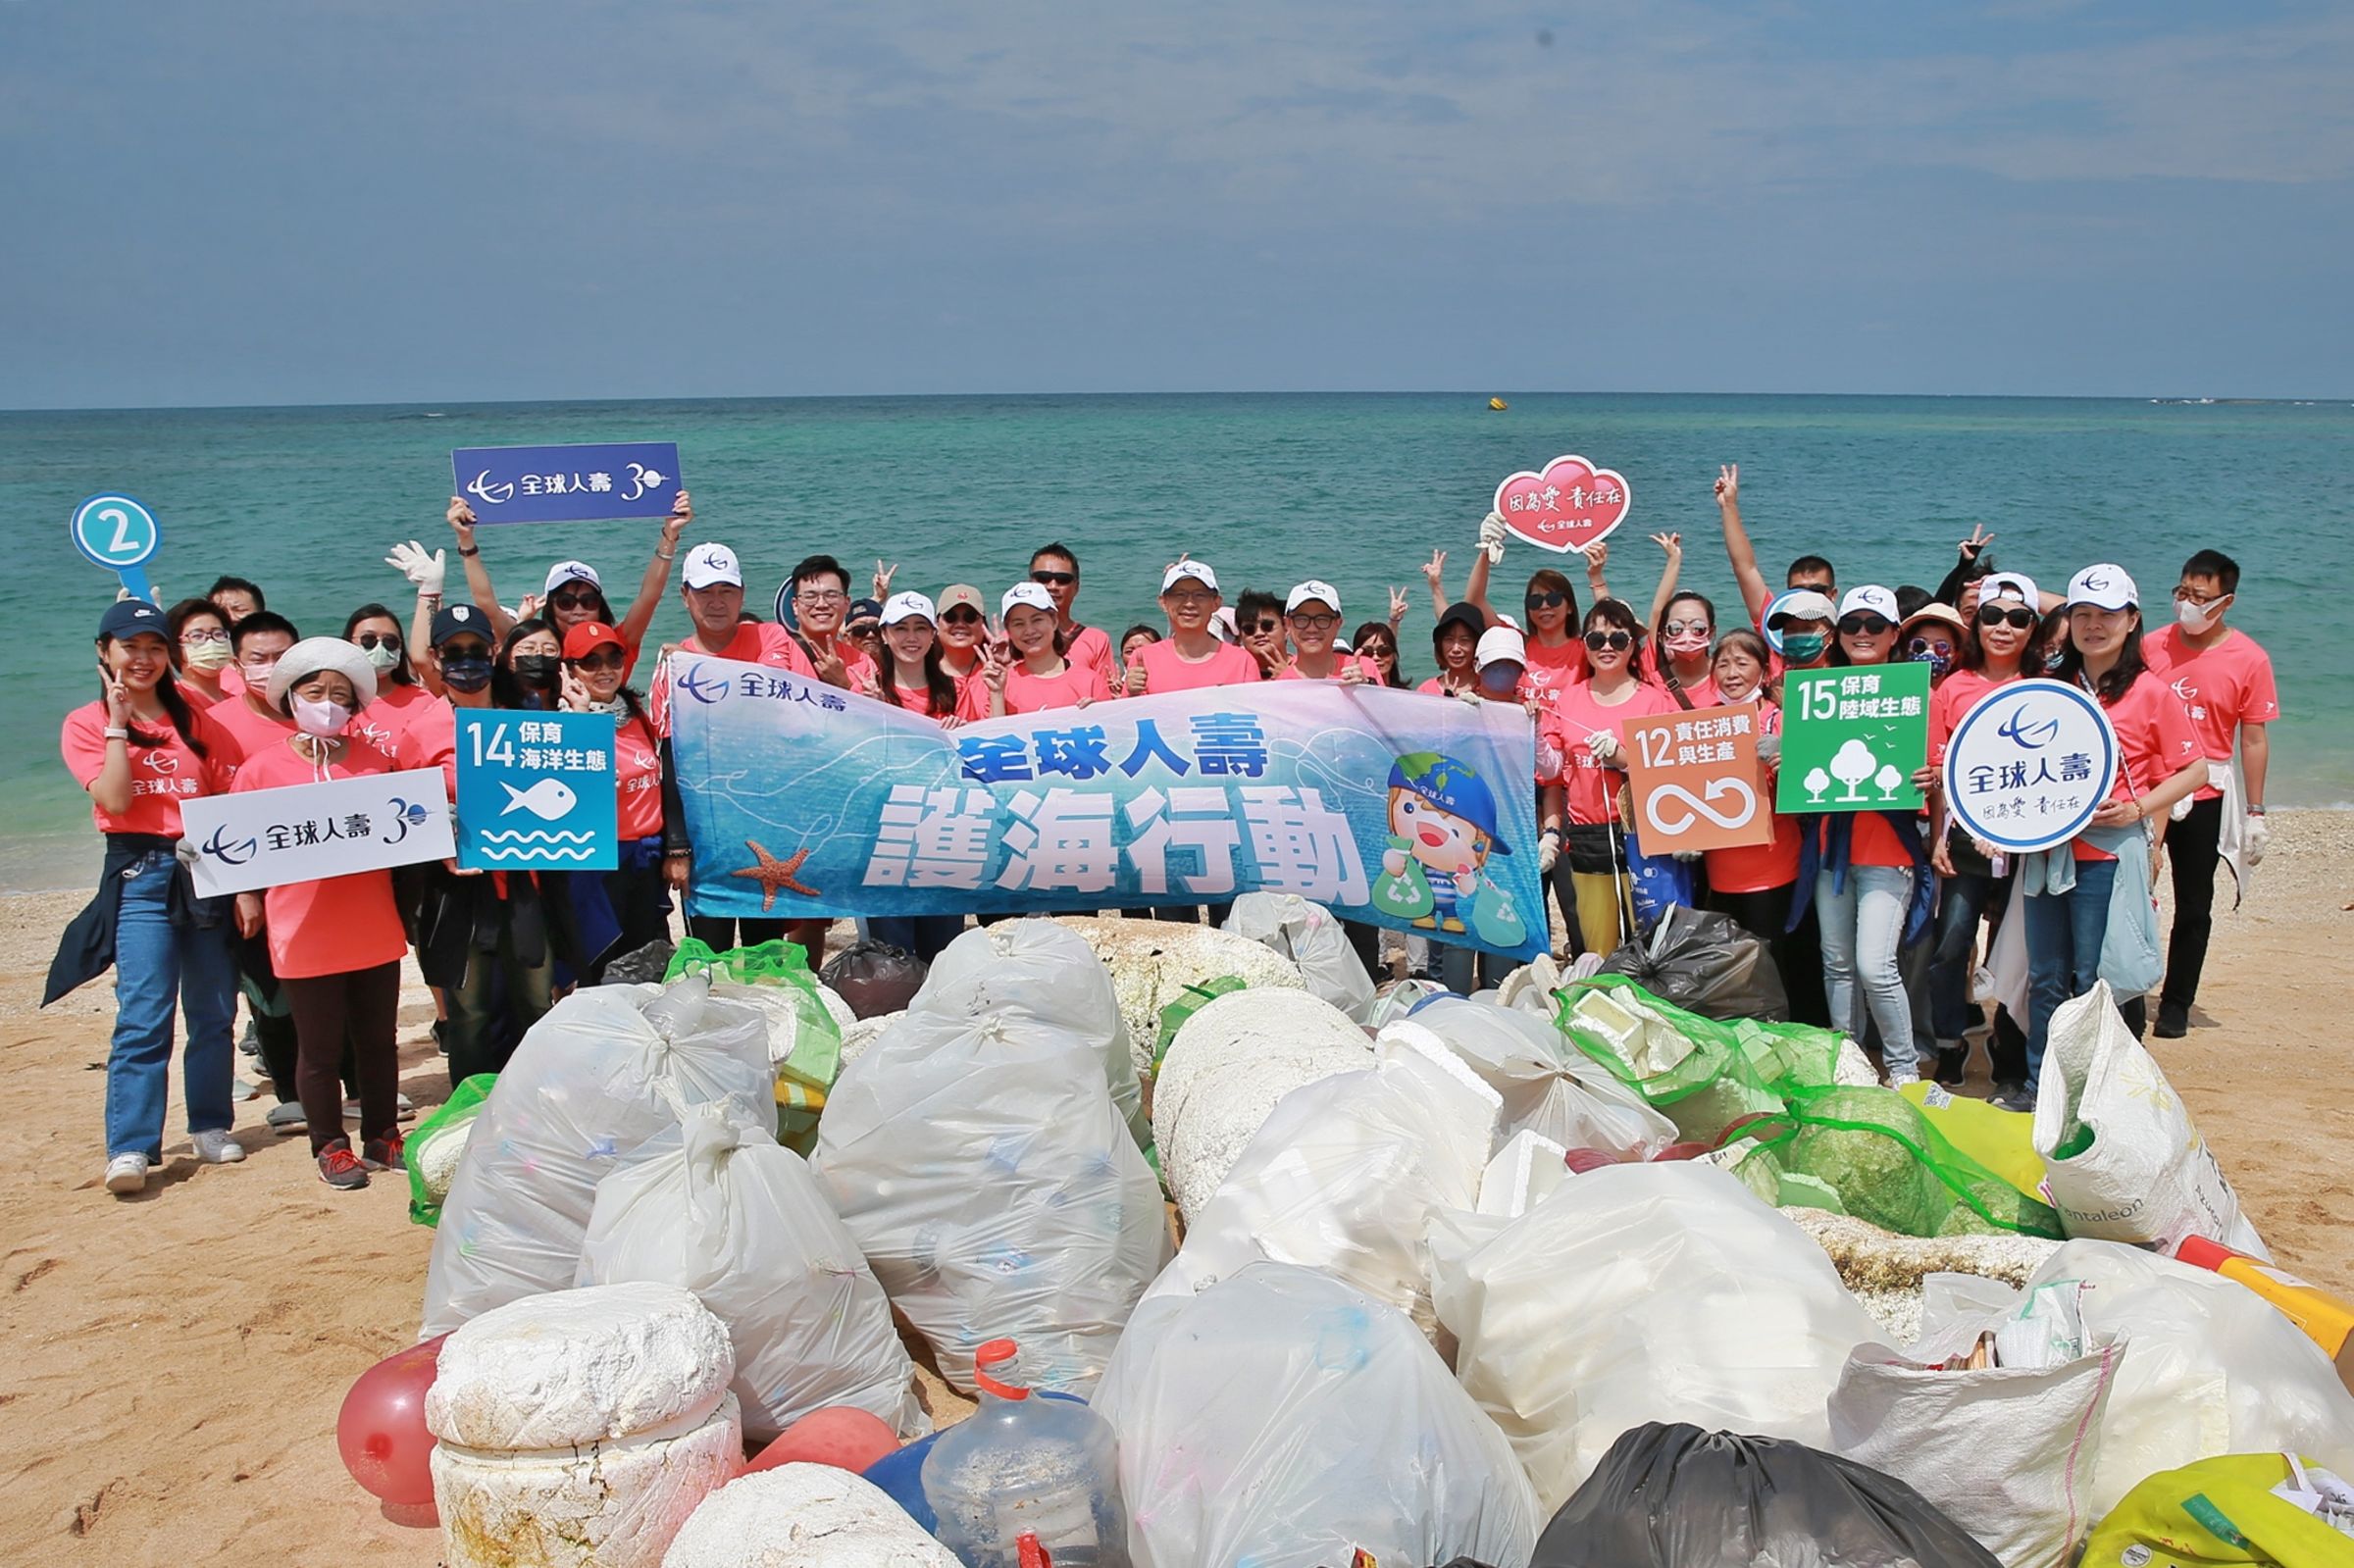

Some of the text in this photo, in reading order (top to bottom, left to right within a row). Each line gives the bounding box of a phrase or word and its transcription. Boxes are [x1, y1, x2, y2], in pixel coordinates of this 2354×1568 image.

[521, 472, 612, 495] 全球人壽
[1567, 486, 1621, 508] 責任在
[99, 509, 139, 552] 2
[741, 673, 846, 711] 全球人壽
[1840, 675, 1881, 696] 保育
[1798, 680, 1836, 720] 15
[1839, 696, 1921, 721] 陸域生態
[519, 721, 562, 743] 保育
[1675, 715, 1752, 743] 責任消費
[467, 722, 515, 767] 14
[957, 713, 1269, 784] 全球人壽
[1635, 728, 1675, 769] 12
[1678, 741, 1736, 766] 與生產
[520, 748, 606, 771] 海洋生態
[626, 774, 660, 792] 全球人
[1969, 752, 2091, 794] 全球人壽
[131, 778, 198, 796] 全球人壽
[266, 813, 371, 851] 全球人壽
[861, 784, 1370, 906] 護海行動
[2059, 1198, 2144, 1222] antaleon
